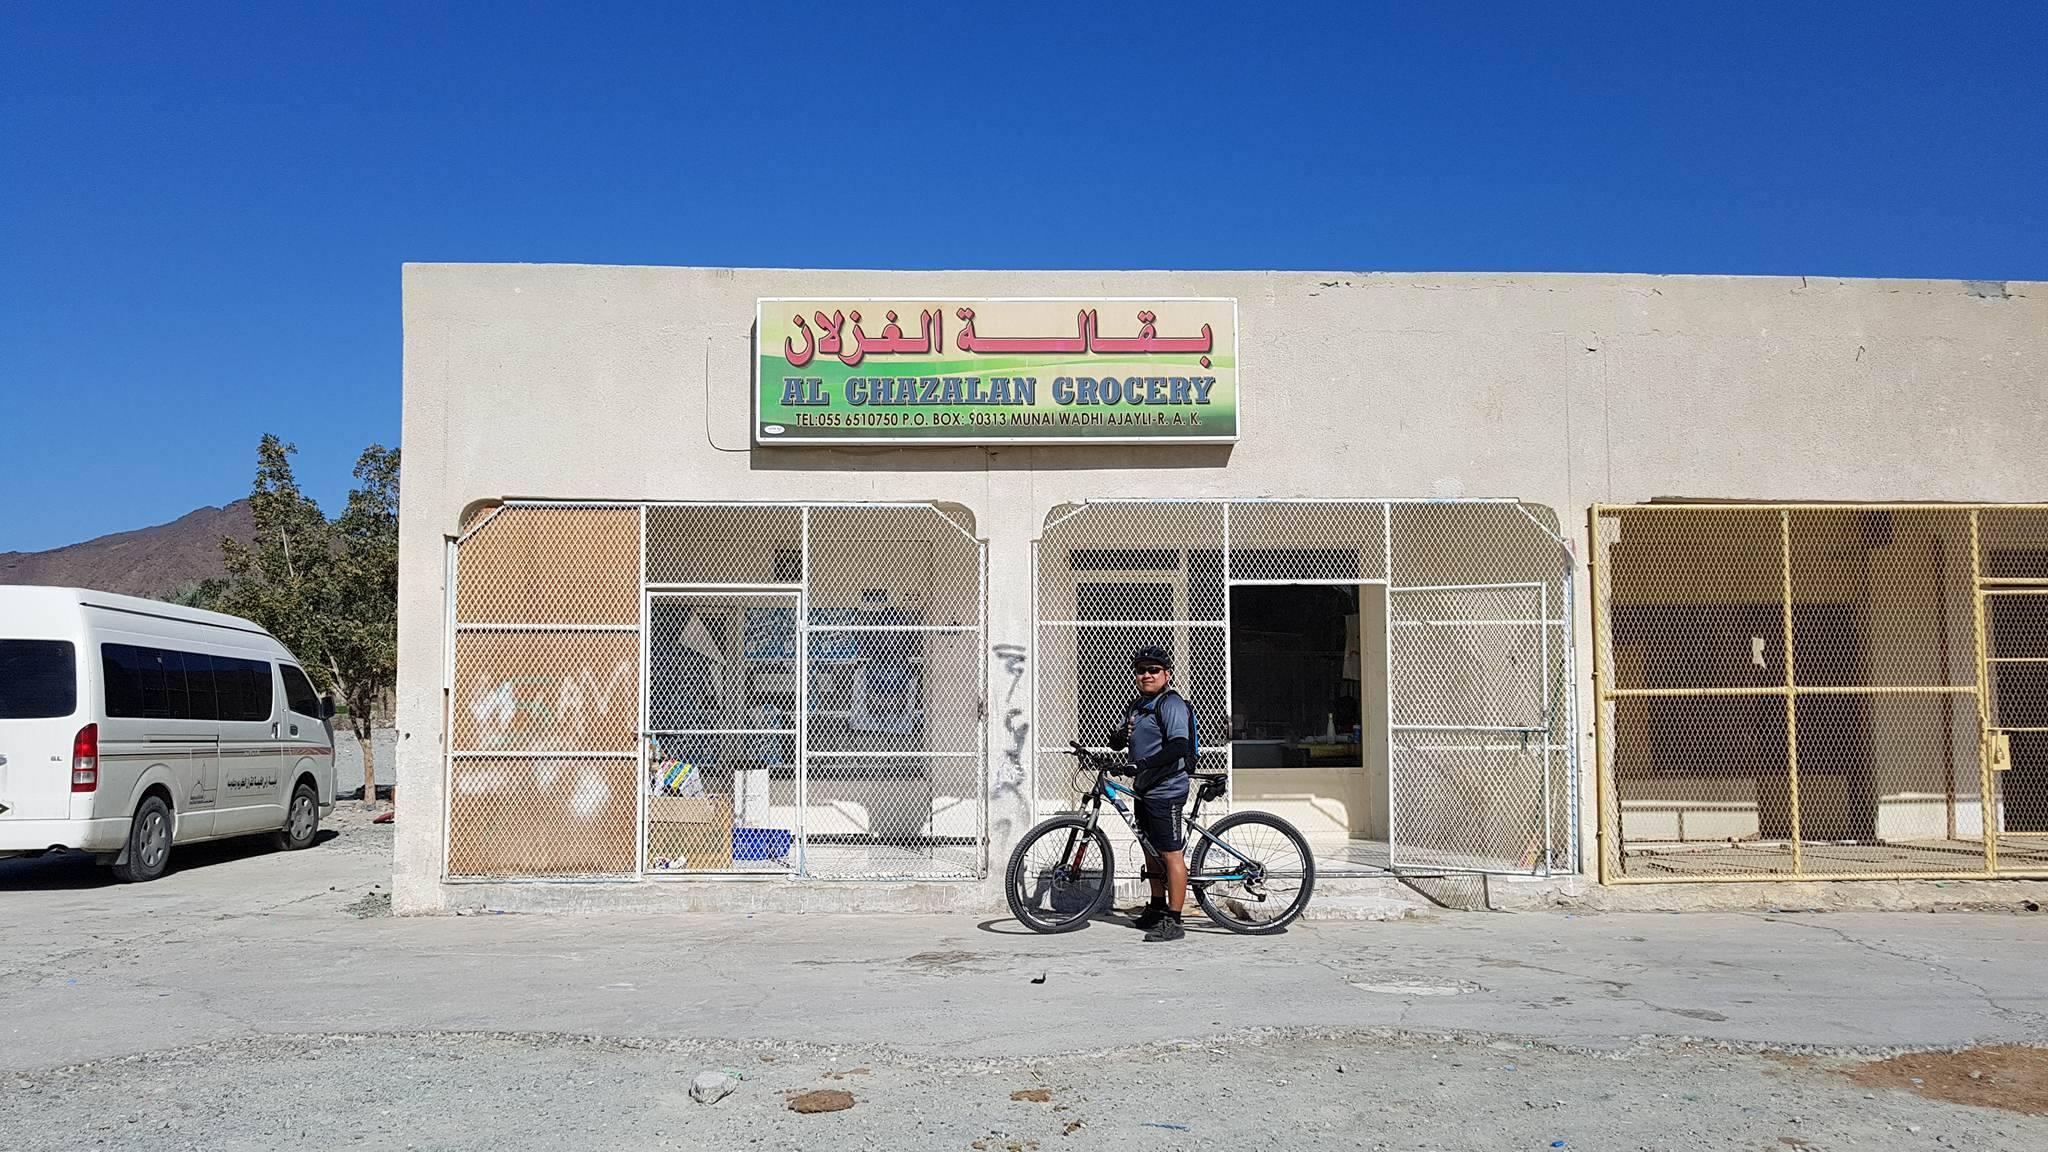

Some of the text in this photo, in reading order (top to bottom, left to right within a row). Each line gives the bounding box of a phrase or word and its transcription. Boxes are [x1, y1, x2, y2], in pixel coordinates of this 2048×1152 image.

[785, 307, 1213, 369] بقالة الغزلان
[781, 376, 1215, 405] AL GHAZALAN GROCERY
[796, 413, 841, 426] TEL:055
[846, 413, 898, 426] 6510750
[903, 413, 928, 425] P.O.
[933, 412, 965, 425] BOX:
[969, 412, 1007, 425] 90313
[1010, 412, 1055, 425] MUNAI
[1059, 412, 1103, 425] WADHI
[1173, 412, 1186, 425] A.
[1190, 412, 1202, 425] K.
